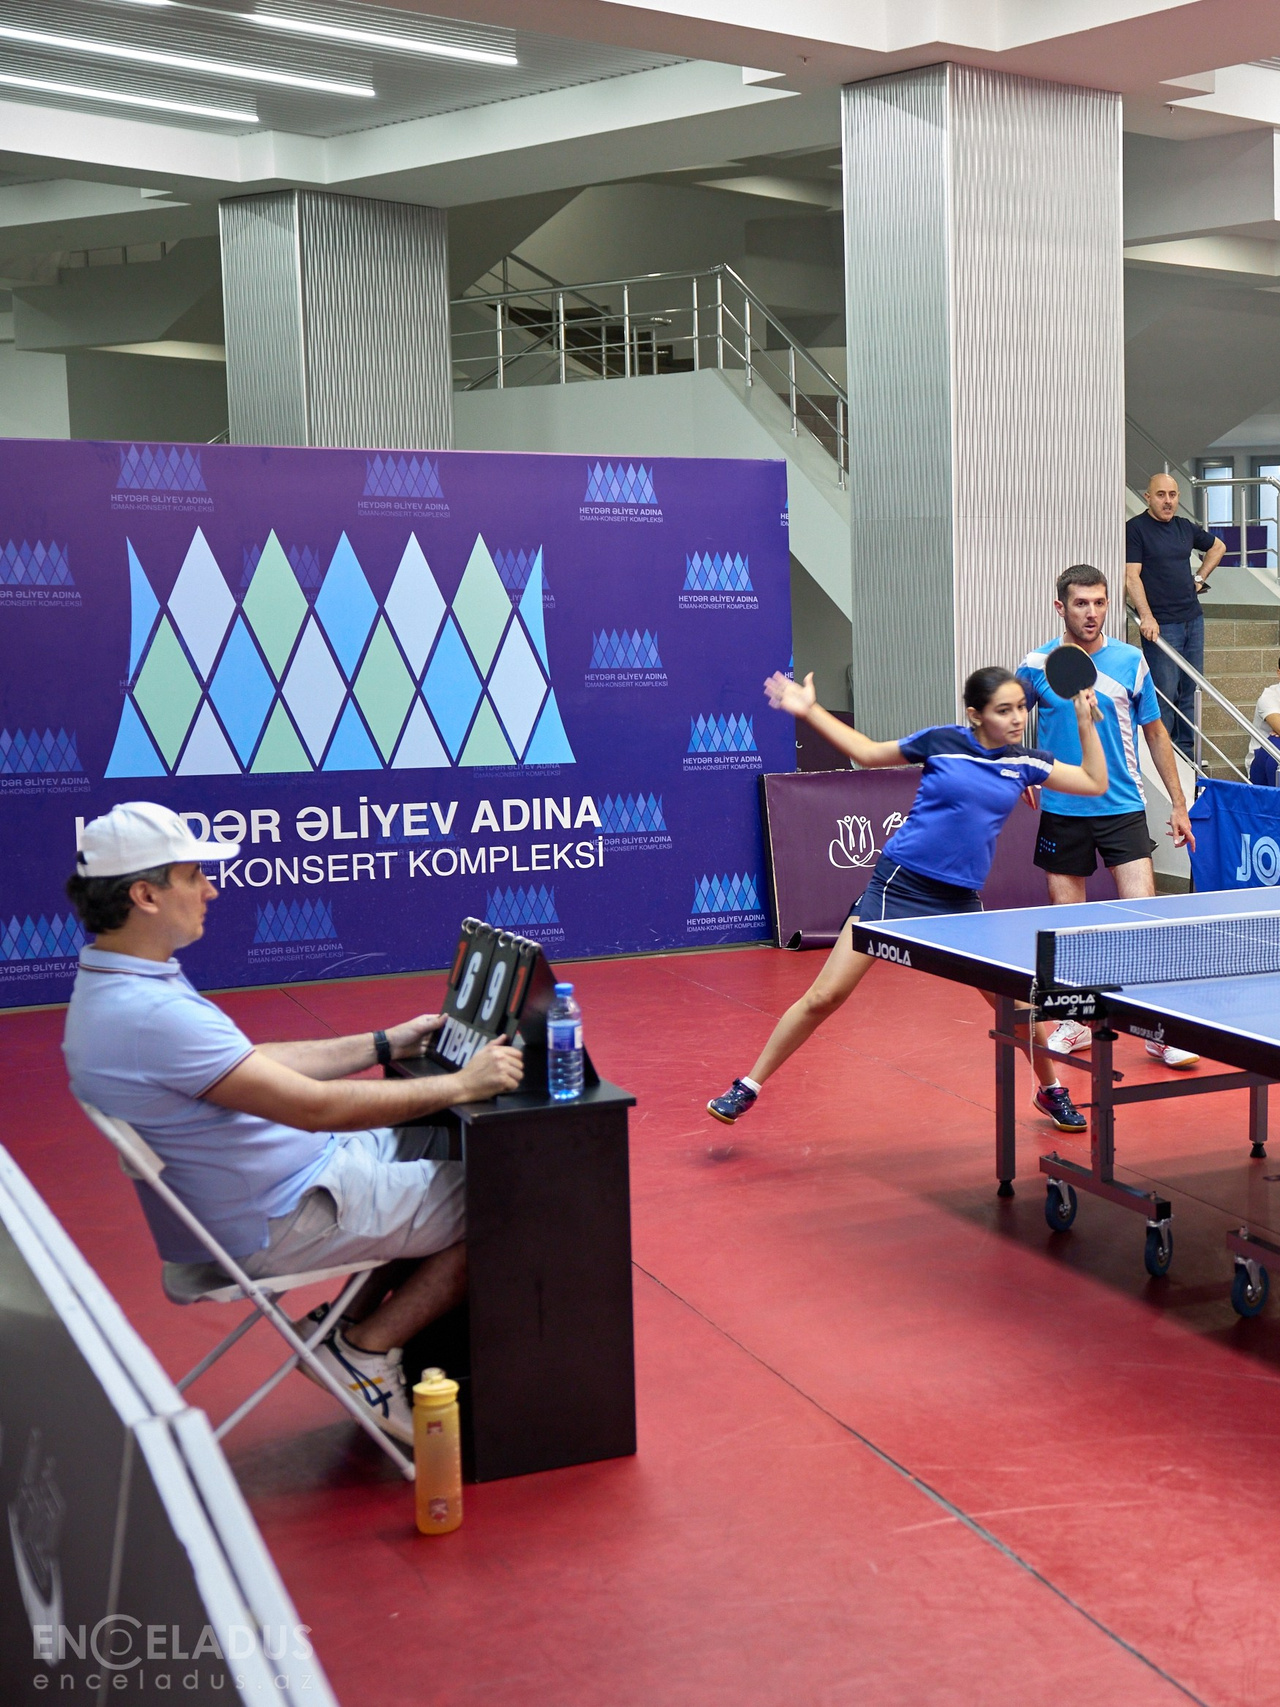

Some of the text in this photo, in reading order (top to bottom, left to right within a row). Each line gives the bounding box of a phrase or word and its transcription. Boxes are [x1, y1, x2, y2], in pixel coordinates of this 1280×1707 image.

[185, 496, 214, 505] ADINA
[640, 508, 663, 516] ADINA
[740, 755, 763, 763] ADINA
[0, 779, 22, 787] DƏR
[295, 796, 459, 842] ƏLİYEV
[470, 795, 602, 834] ADINA
[206, 835, 604, 889] -KONSERT KOMPLEKSİ
[744, 914, 766, 922] ADINA
[317, 943, 344, 952] ADINA
[875, 941, 912, 967] JOOLA
[456, 951, 483, 1010] 6
[481, 961, 507, 1021] 9
[1054, 993, 1096, 1006] JOOLA
